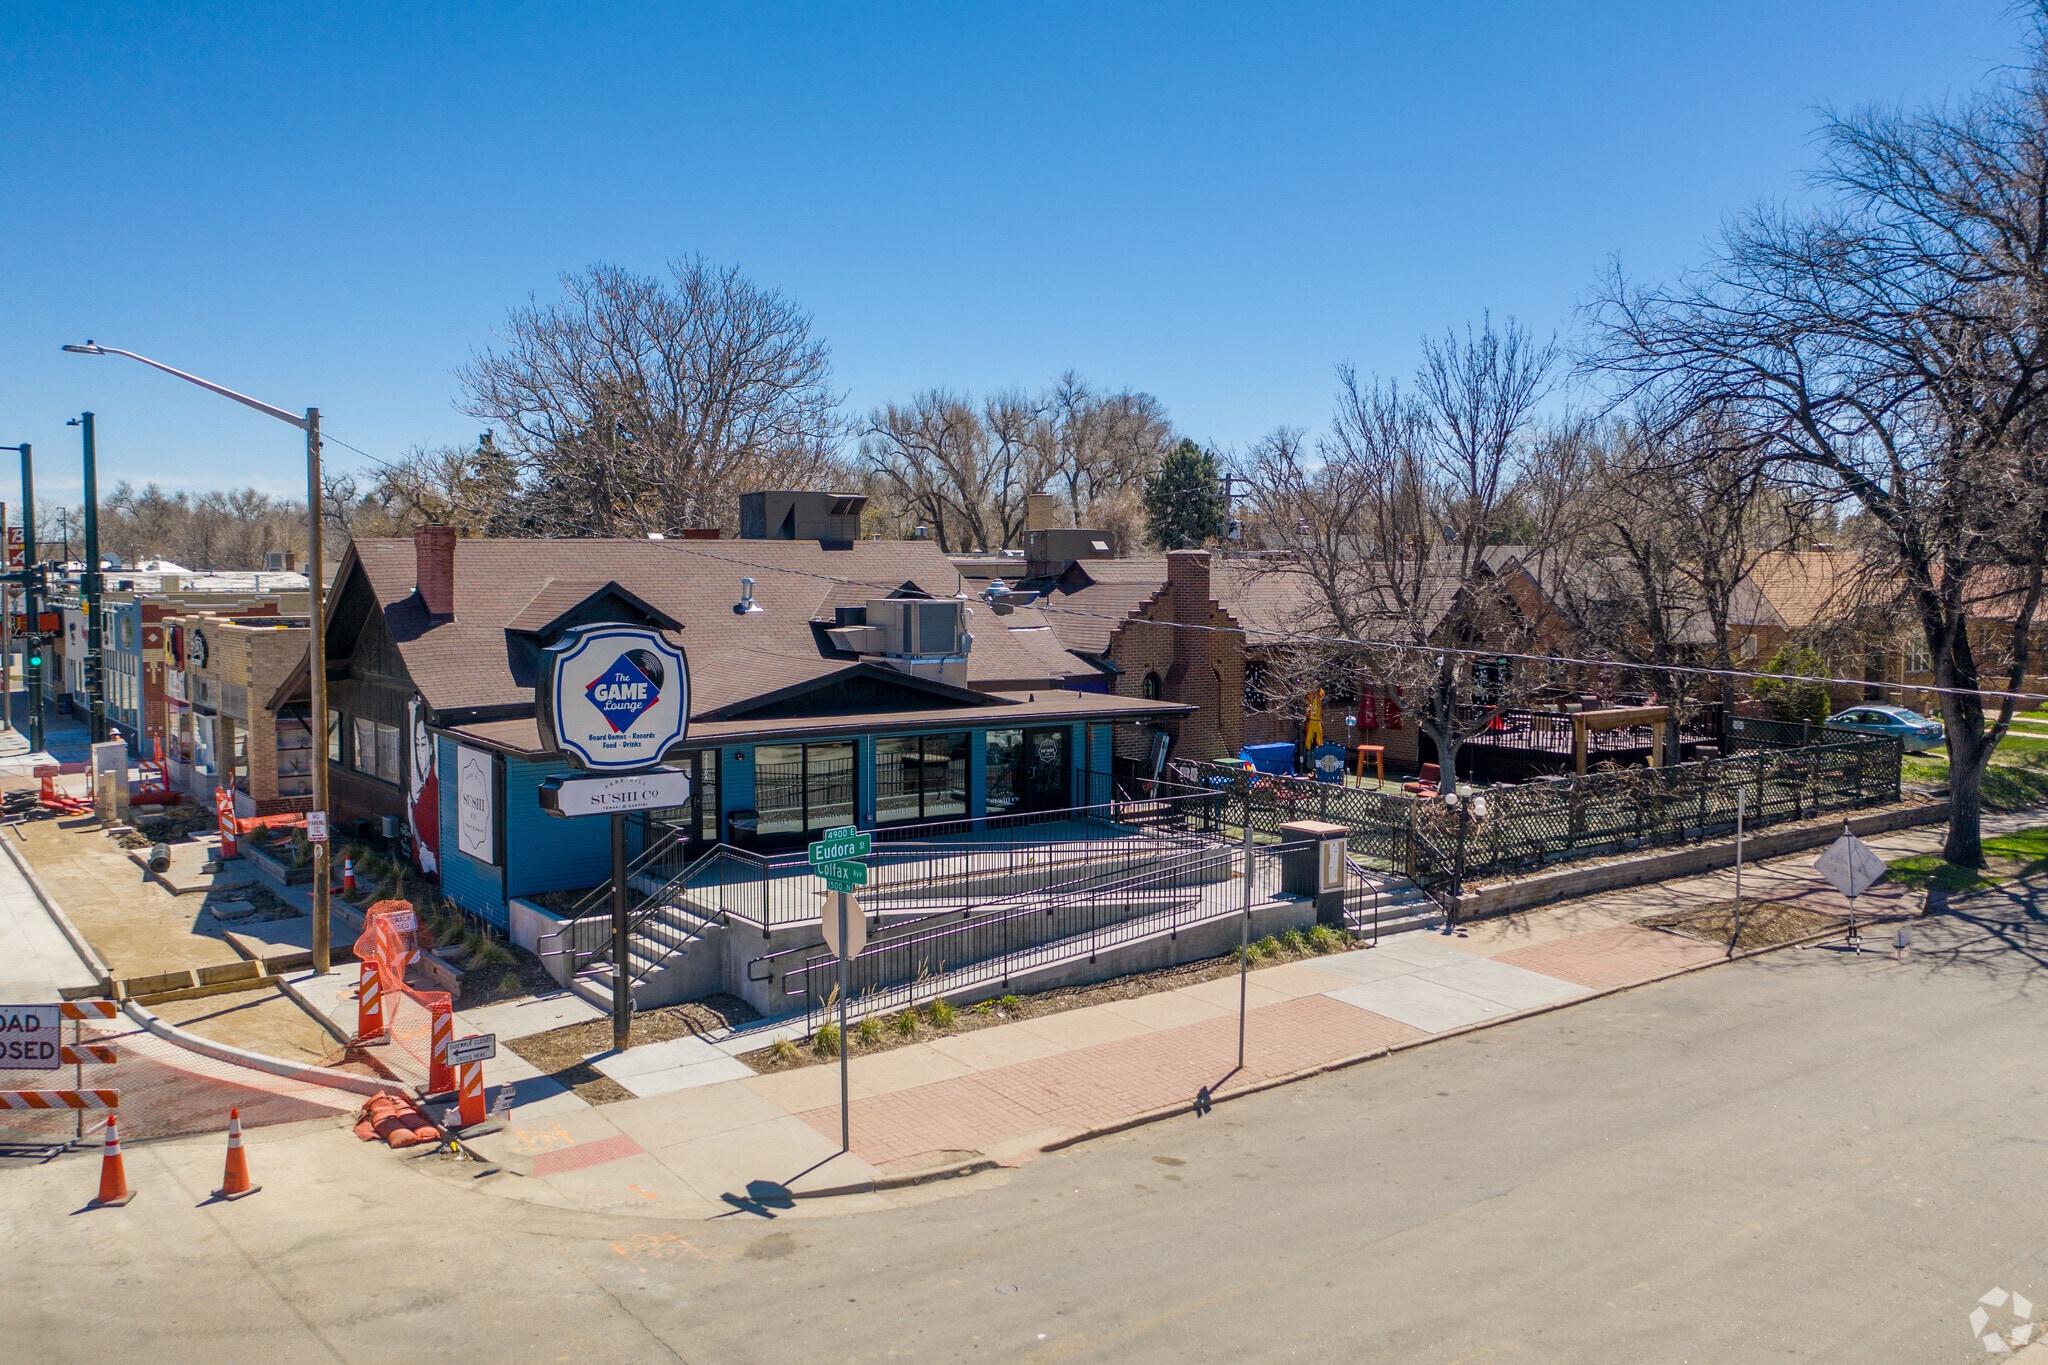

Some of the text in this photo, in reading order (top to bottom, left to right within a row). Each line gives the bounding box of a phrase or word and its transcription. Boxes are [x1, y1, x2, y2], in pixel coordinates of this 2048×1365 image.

[615, 672, 630, 682] The
[594, 682, 648, 702] GAME
[603, 700, 643, 713] Lounge
[607, 733, 627, 741] Games
[632, 732, 655, 740] Records
[602, 740, 641, 749] Food Drinks
[463, 793, 485, 812] SUSHI
[591, 791, 637, 805] SUSHI
[828, 828, 855, 839] 4900 E
[815, 841, 865, 860] Eudora St
[817, 863, 863, 879] Colfax Ave
[828, 881, 851, 892] 1500 N
[449, 1036, 493, 1051] SIDEWALK CLOSED
[455, 1051, 486, 1062] CROSS HERE
